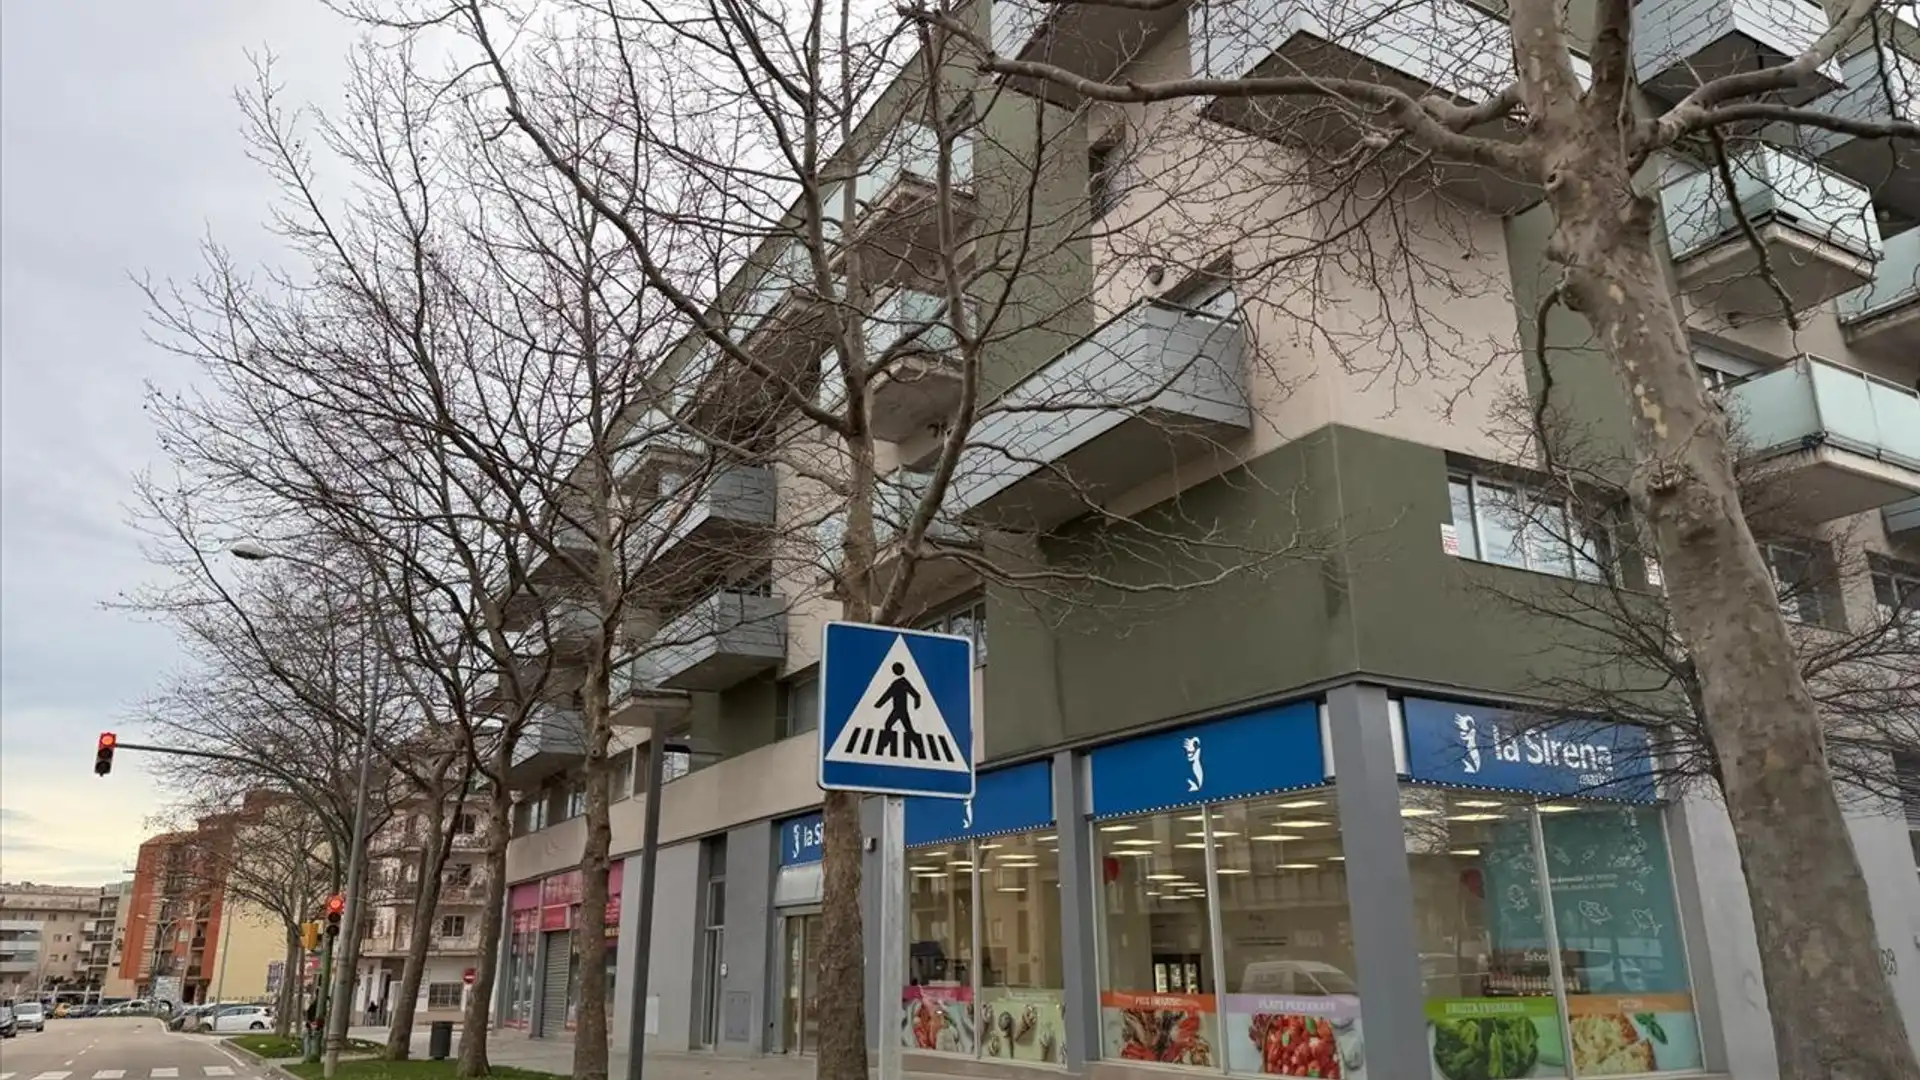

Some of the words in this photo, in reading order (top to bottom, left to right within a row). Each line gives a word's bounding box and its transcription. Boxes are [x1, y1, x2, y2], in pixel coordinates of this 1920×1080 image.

[1492, 724, 1521, 762] la
[1524, 727, 1614, 774] Sirena
[803, 825, 813, 847] la
